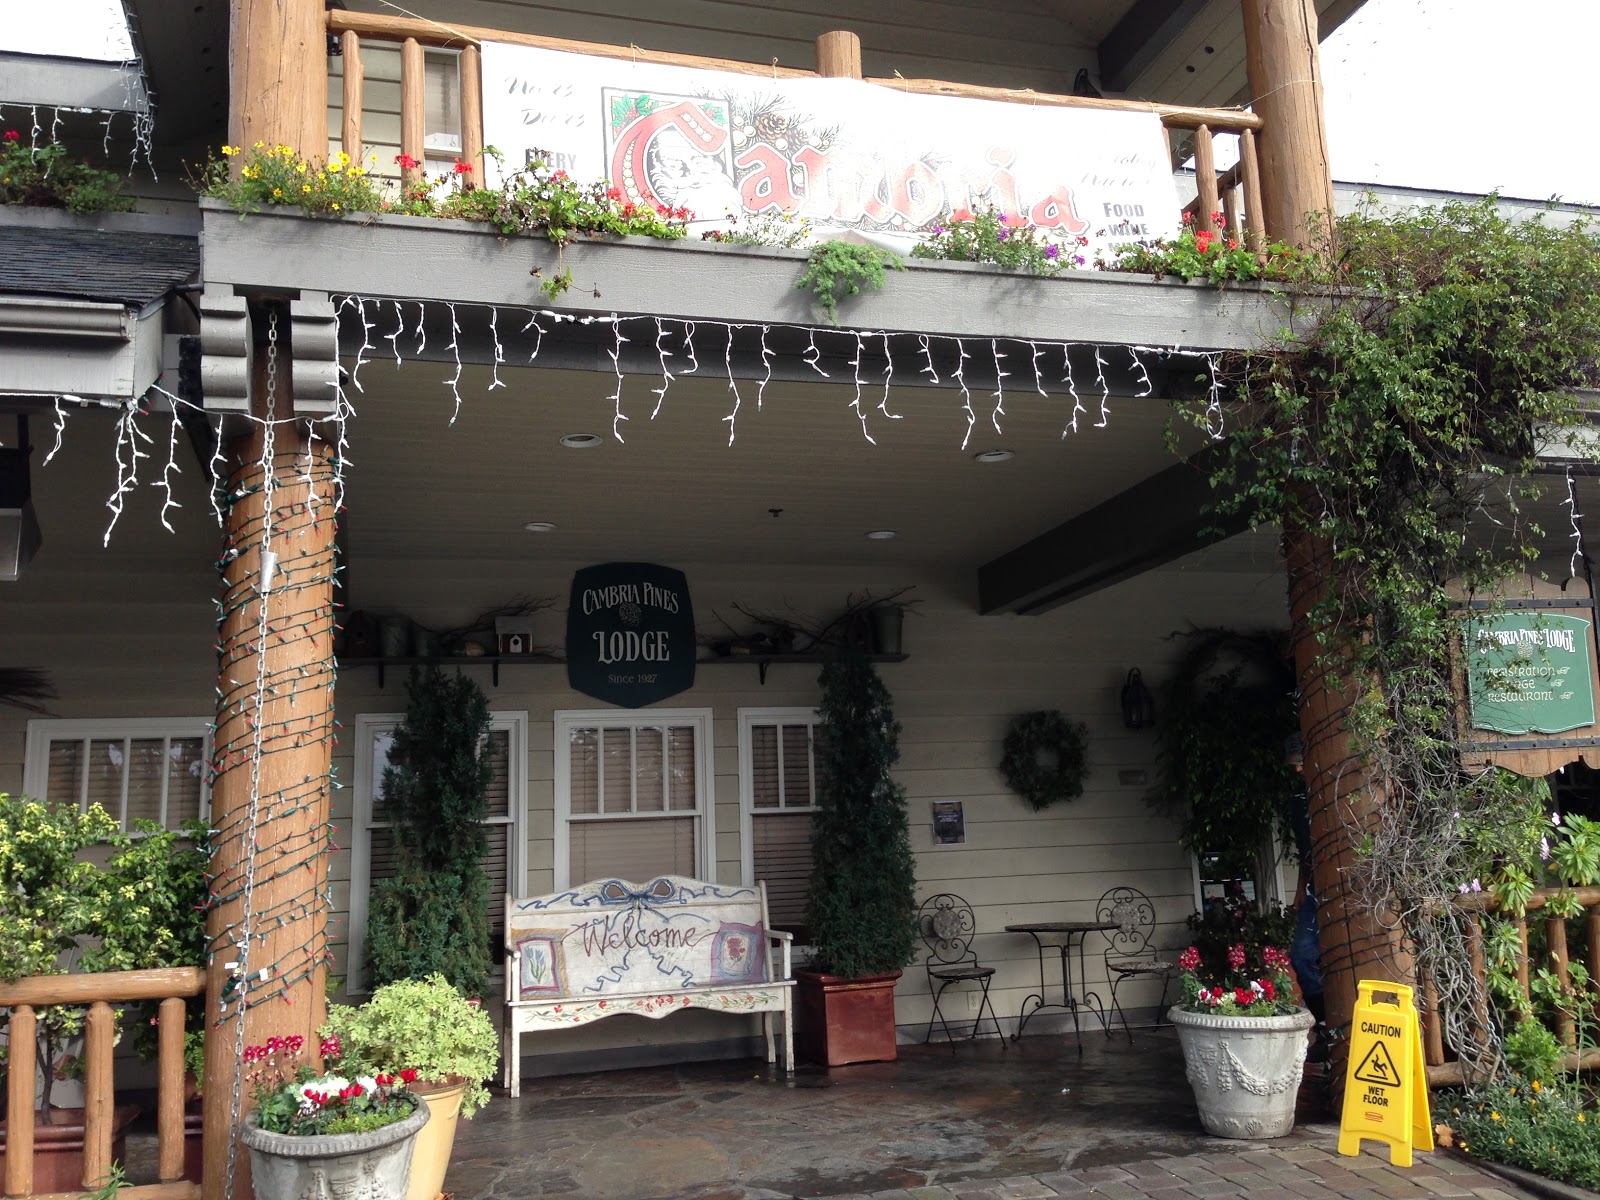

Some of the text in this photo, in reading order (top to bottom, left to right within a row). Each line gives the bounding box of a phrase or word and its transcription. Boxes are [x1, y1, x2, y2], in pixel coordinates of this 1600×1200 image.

[582, 582, 680, 616] CAMBRIA PINES
[592, 630, 670, 665] LODGE
[1542, 628, 1576, 653] LODGE
[608, 673, 658, 685] Since 1927
[566, 914, 706, 957] Welcome
[1361, 1021, 1401, 1038] CAUTION
[1363, 1094, 1388, 1107] FLOOR
[1368, 1086, 1385, 1096] WET
